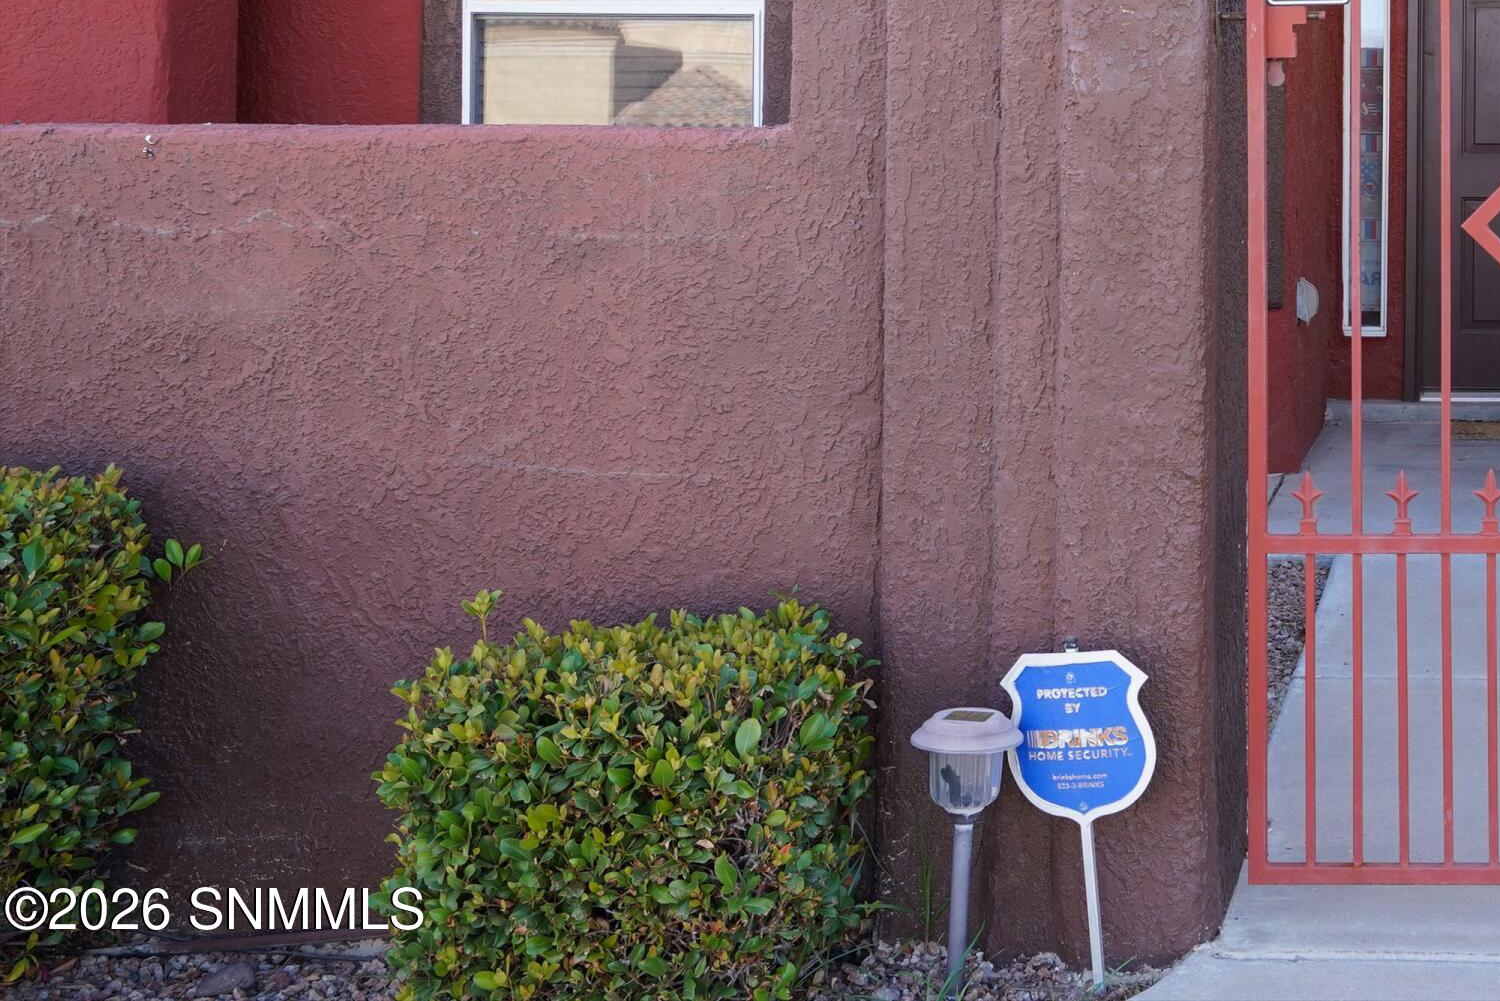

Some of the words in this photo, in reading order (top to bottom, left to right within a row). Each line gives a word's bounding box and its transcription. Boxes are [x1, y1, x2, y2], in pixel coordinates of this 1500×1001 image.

[1036, 686, 1108, 700] PROTECTED
[1064, 703, 1081, 714] BY
[1038, 726, 1129, 749] BRINKS
[1028, 751, 1064, 762] HOME
[1067, 748, 1128, 761] SECURITY
